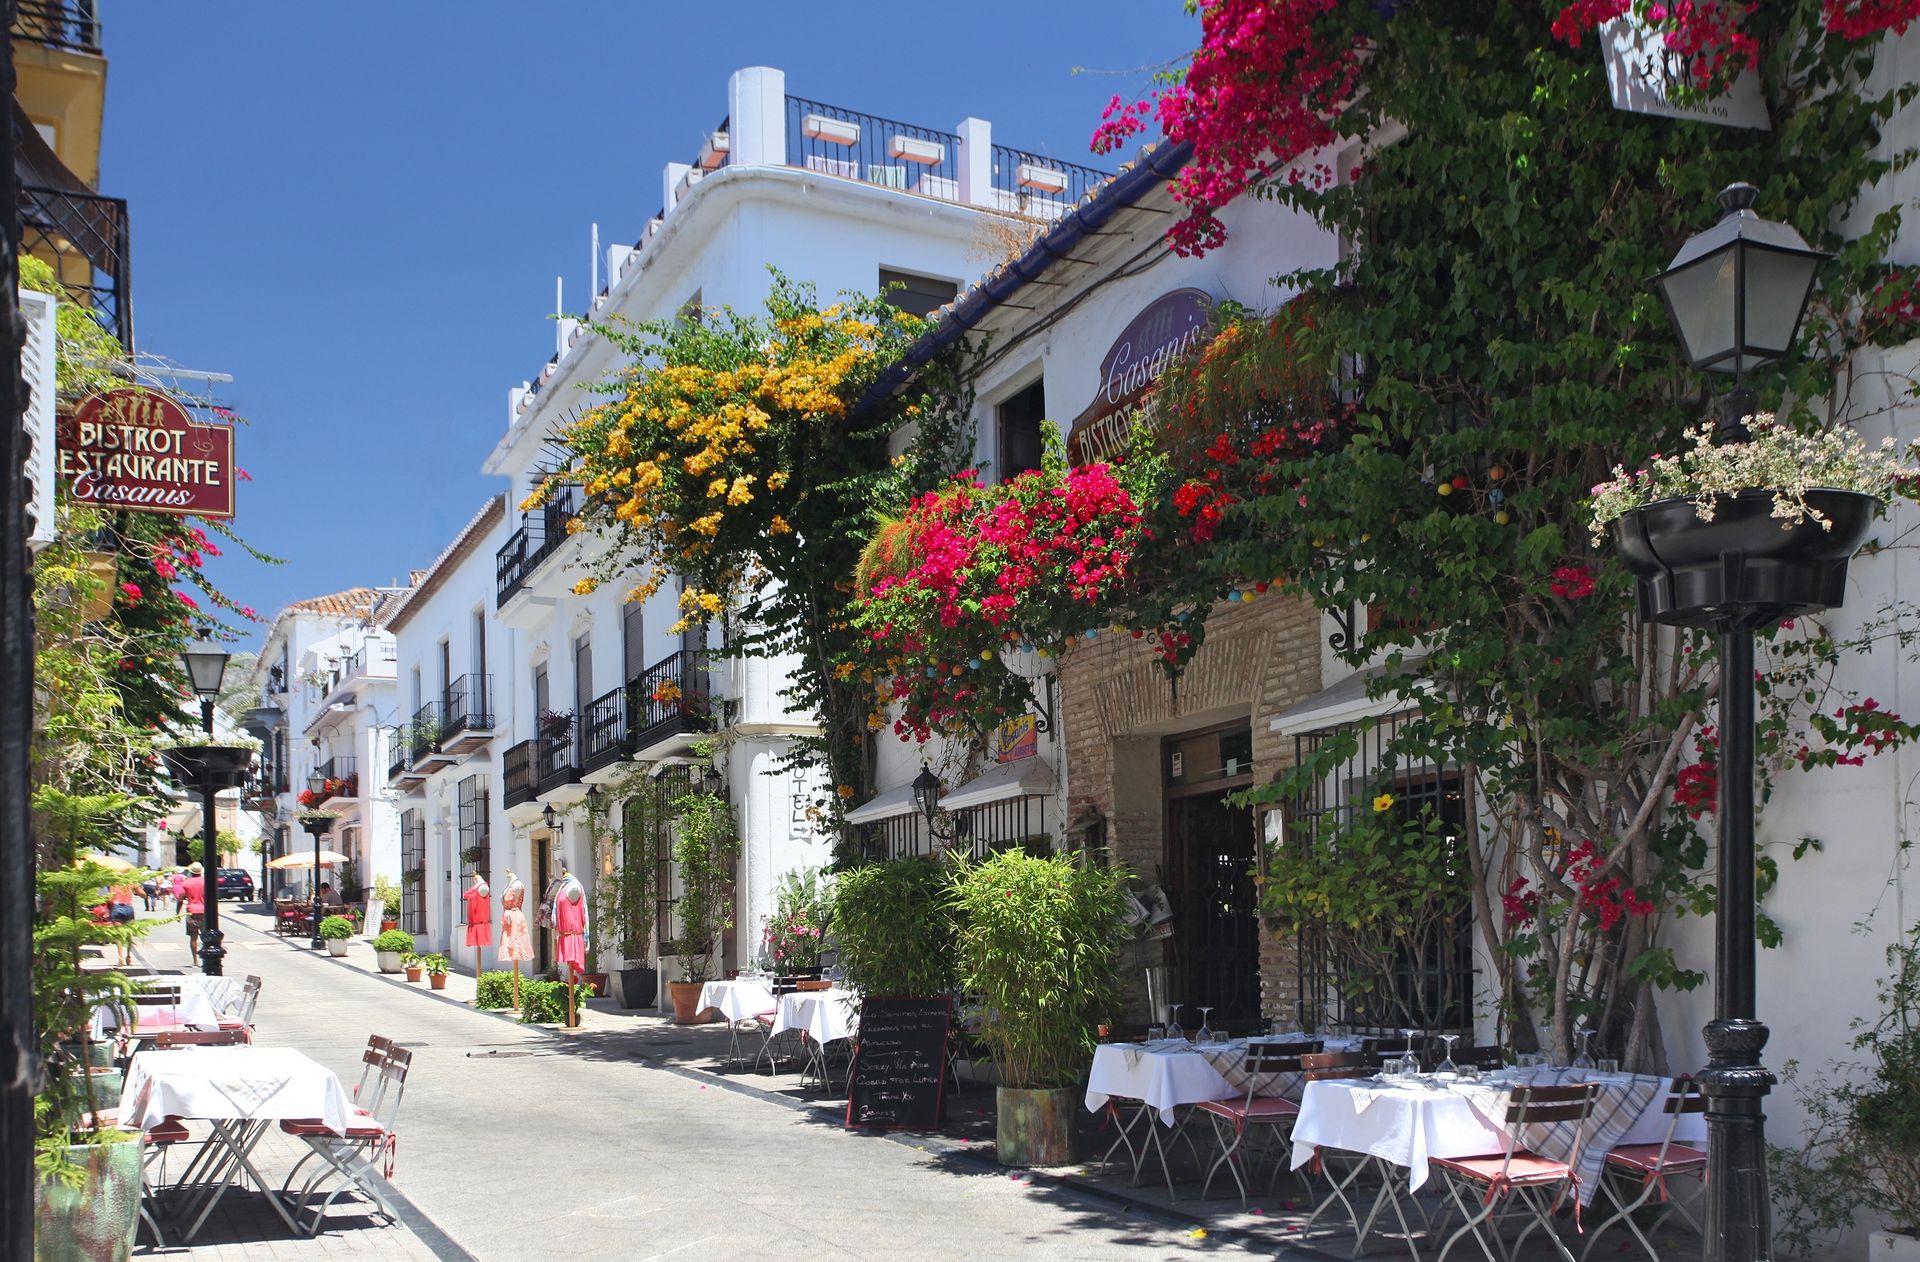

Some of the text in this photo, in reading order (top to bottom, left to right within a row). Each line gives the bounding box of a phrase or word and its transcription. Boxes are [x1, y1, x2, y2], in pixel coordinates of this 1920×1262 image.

[1107, 314, 1200, 405] Casanis
[80, 421, 186, 454] BISTROT
[1079, 402, 1133, 464] BISTROT
[54, 448, 220, 486] ESTAURANTE
[71, 469, 195, 506] Casanis
[792, 765, 808, 823] OTEL
